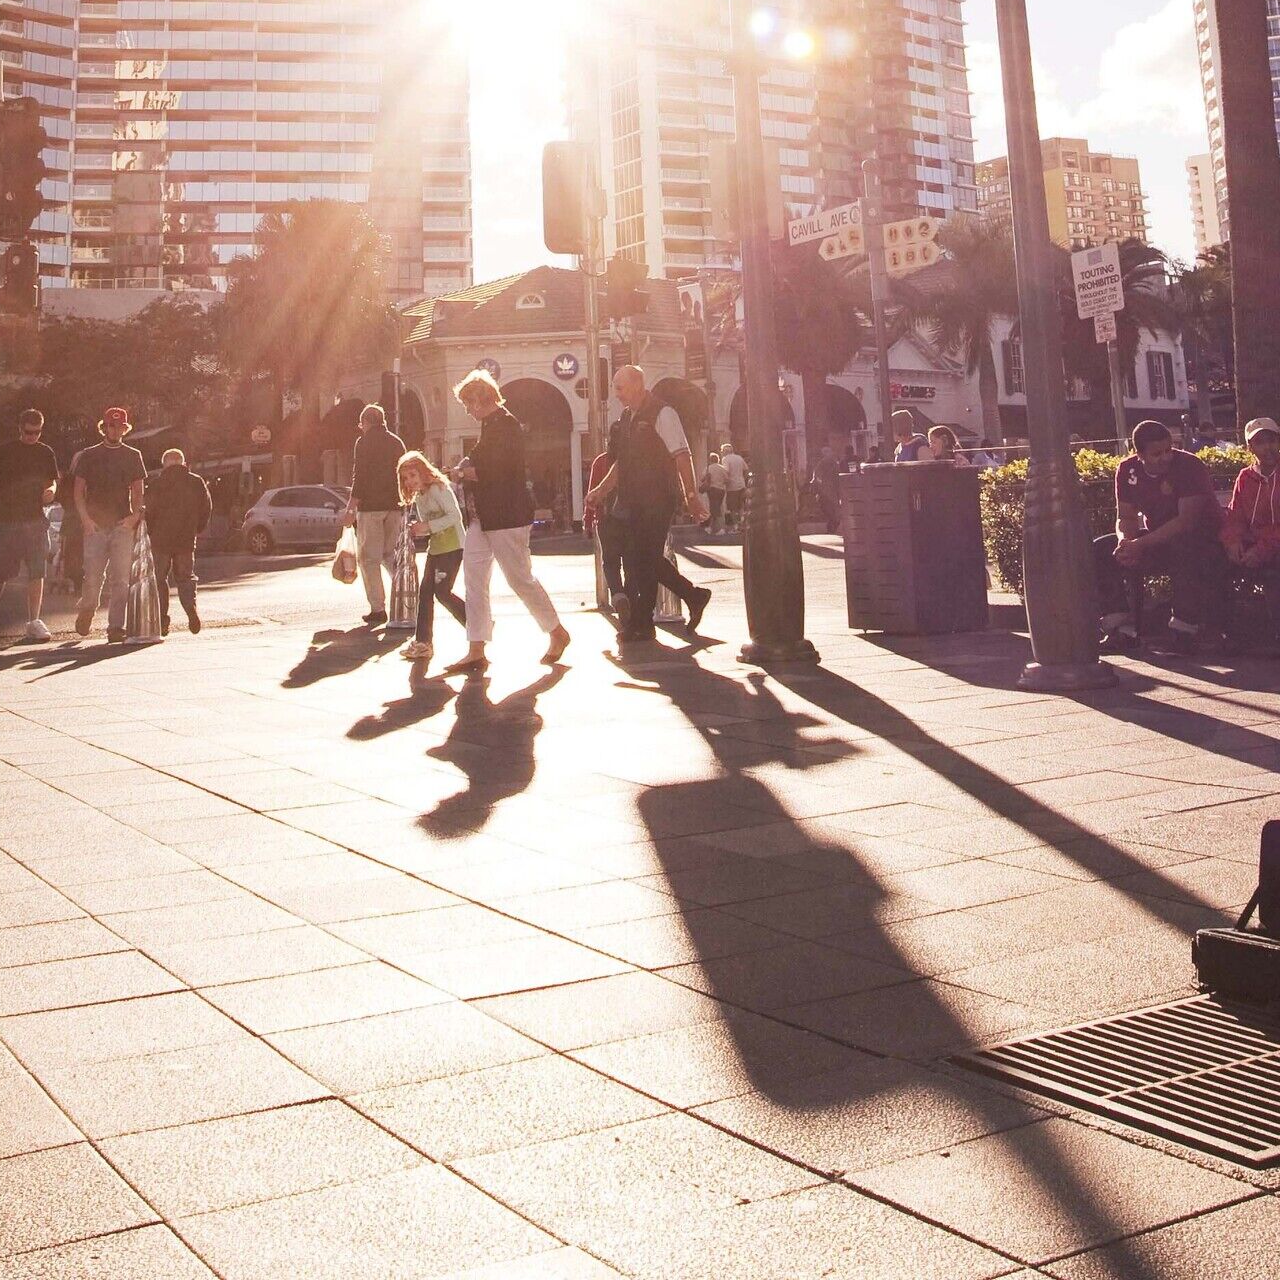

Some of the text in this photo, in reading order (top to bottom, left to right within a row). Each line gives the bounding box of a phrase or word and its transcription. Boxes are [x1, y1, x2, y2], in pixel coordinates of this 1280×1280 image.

[791, 211, 848, 240] CAVILL AVE
[1080, 264, 1115, 280] TOUTING
[1078, 274, 1120, 293] PROHIBITED
[1107, 293, 1118, 302] CITY
